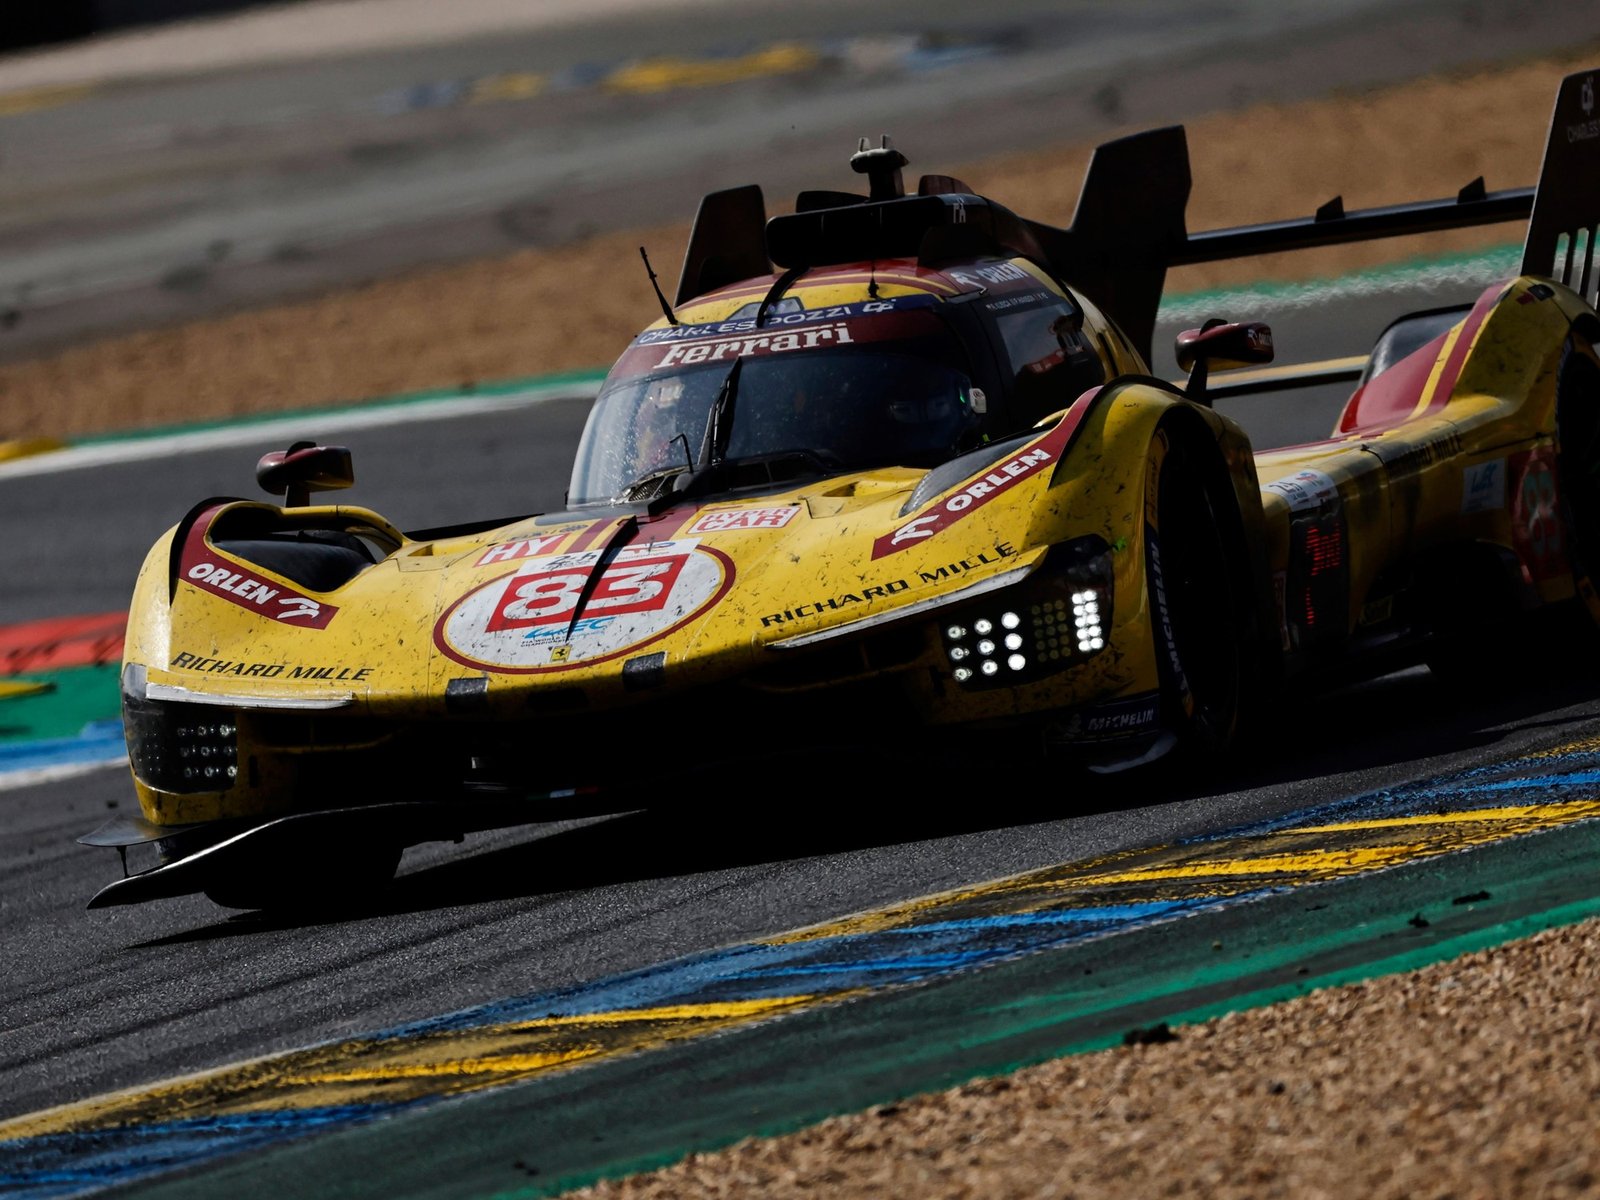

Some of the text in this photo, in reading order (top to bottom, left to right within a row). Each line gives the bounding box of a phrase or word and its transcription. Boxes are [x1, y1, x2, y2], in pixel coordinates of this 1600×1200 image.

[976, 262, 1029, 283] ORLEN
[639, 319, 757, 345] CHARLES
[653, 322, 855, 369] Ferrari
[945, 449, 1052, 512] ORLEN
[696, 515, 784, 531] CAR
[705, 508, 792, 521] HYPER
[478, 534, 565, 566] HY
[188, 563, 280, 605] ORLEN
[502, 561, 675, 620] 83
[761, 542, 1019, 628] RICHARD MILLE
[1150, 541, 1184, 673] MICHELIN
[170, 651, 375, 681] RICHARD MILLE
[1087, 709, 1155, 731] MICHELIN
